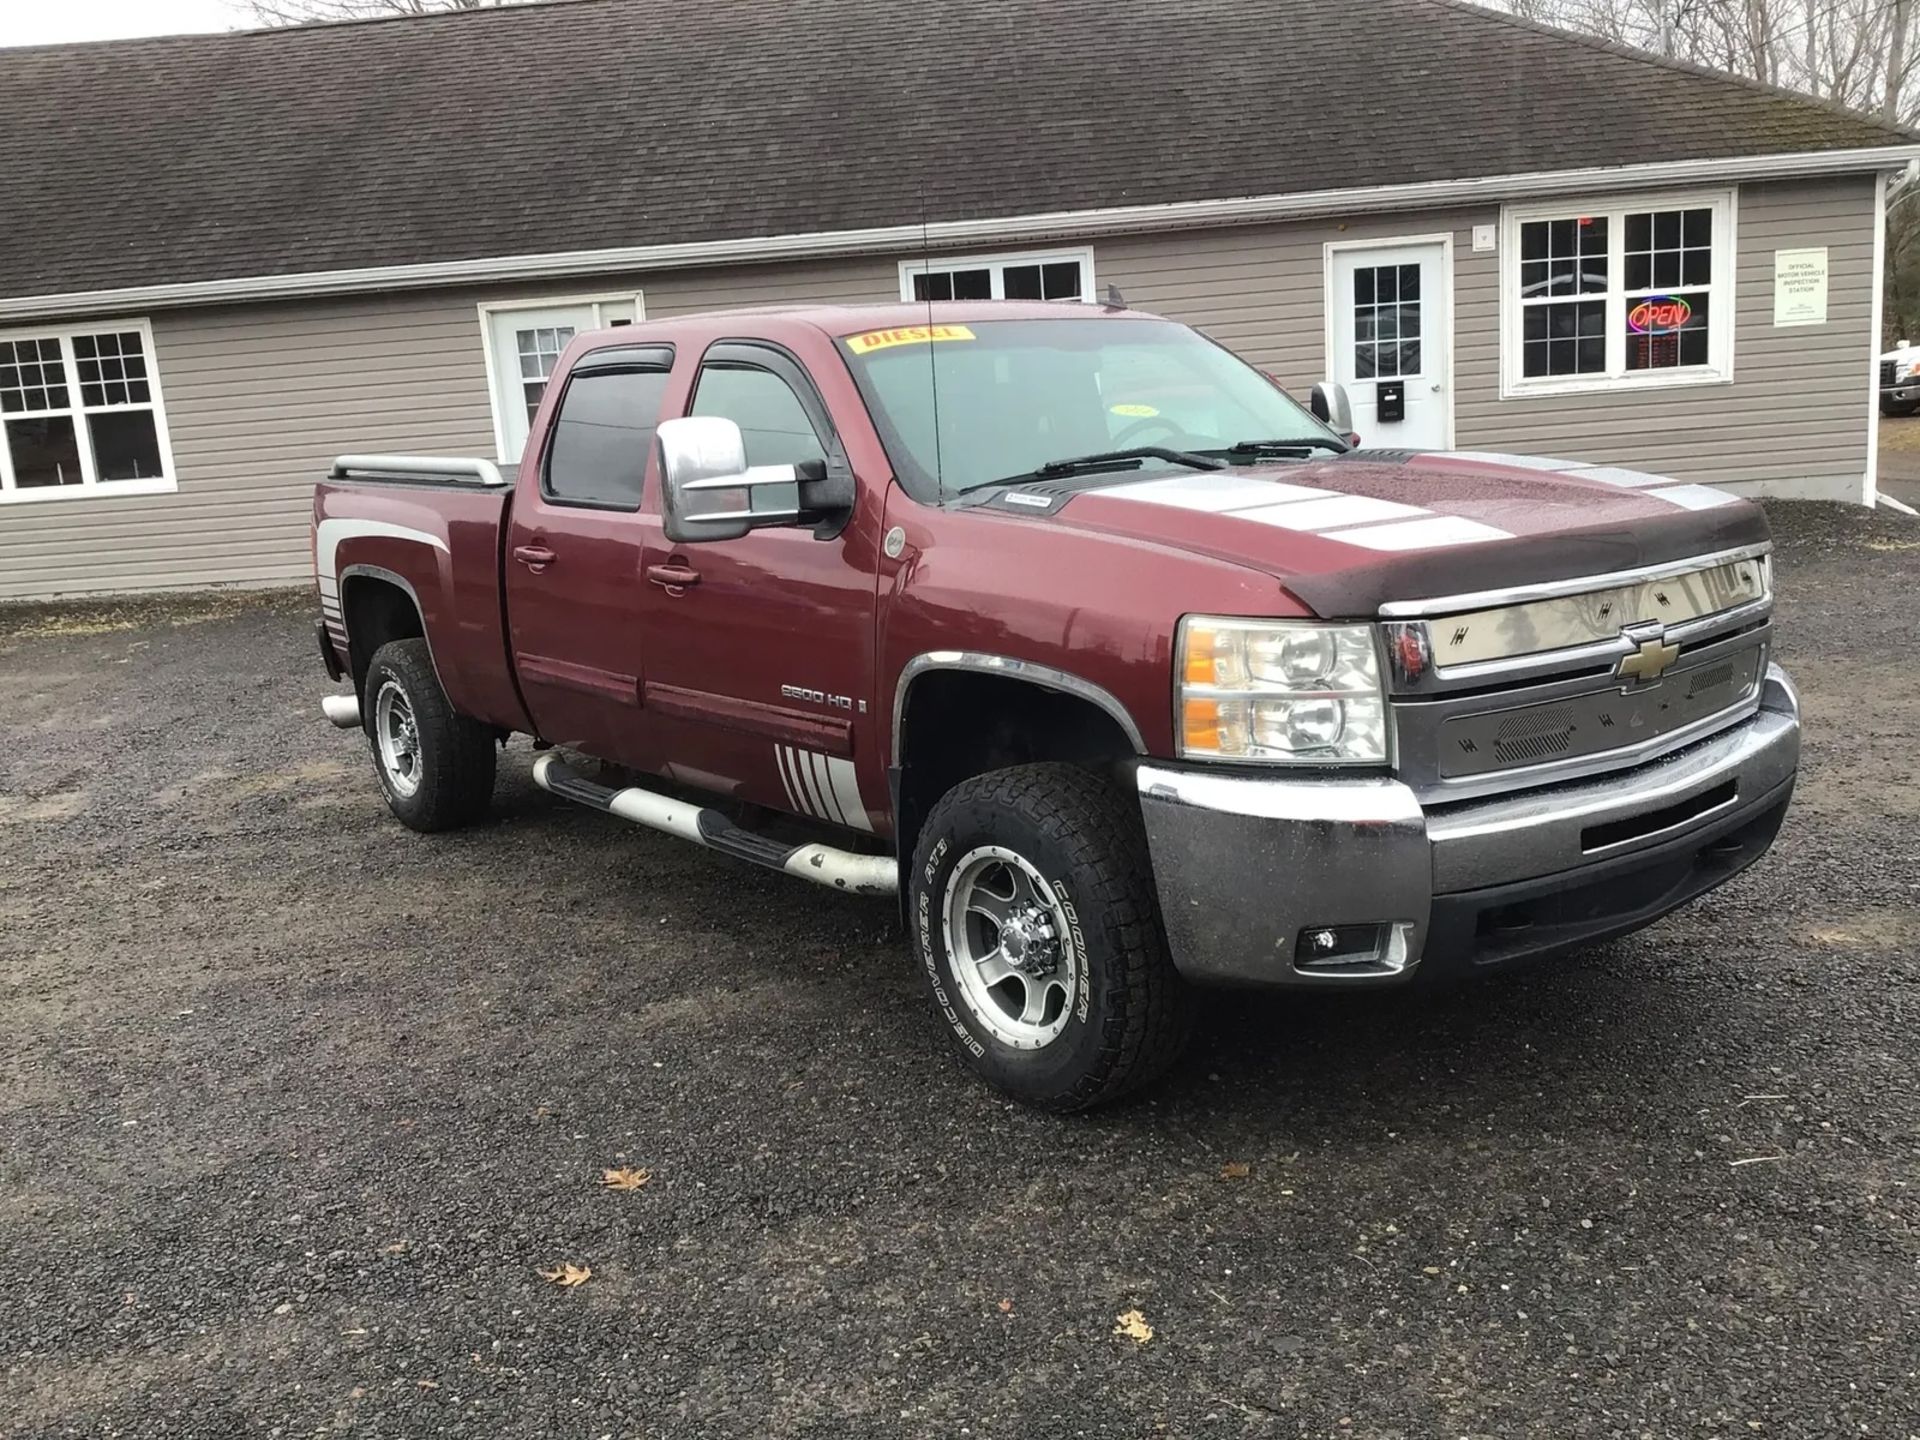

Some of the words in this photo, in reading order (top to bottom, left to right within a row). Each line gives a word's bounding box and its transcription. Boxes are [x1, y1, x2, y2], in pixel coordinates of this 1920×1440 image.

[1632, 304, 1685, 326] OPEN
[862, 327, 958, 347] DIESEL
[827, 693, 852, 710] HD
[924, 838, 948, 884] AT3
[1052, 879, 1089, 1024] COOPER
[919, 891, 985, 1058] DISCOVERER
